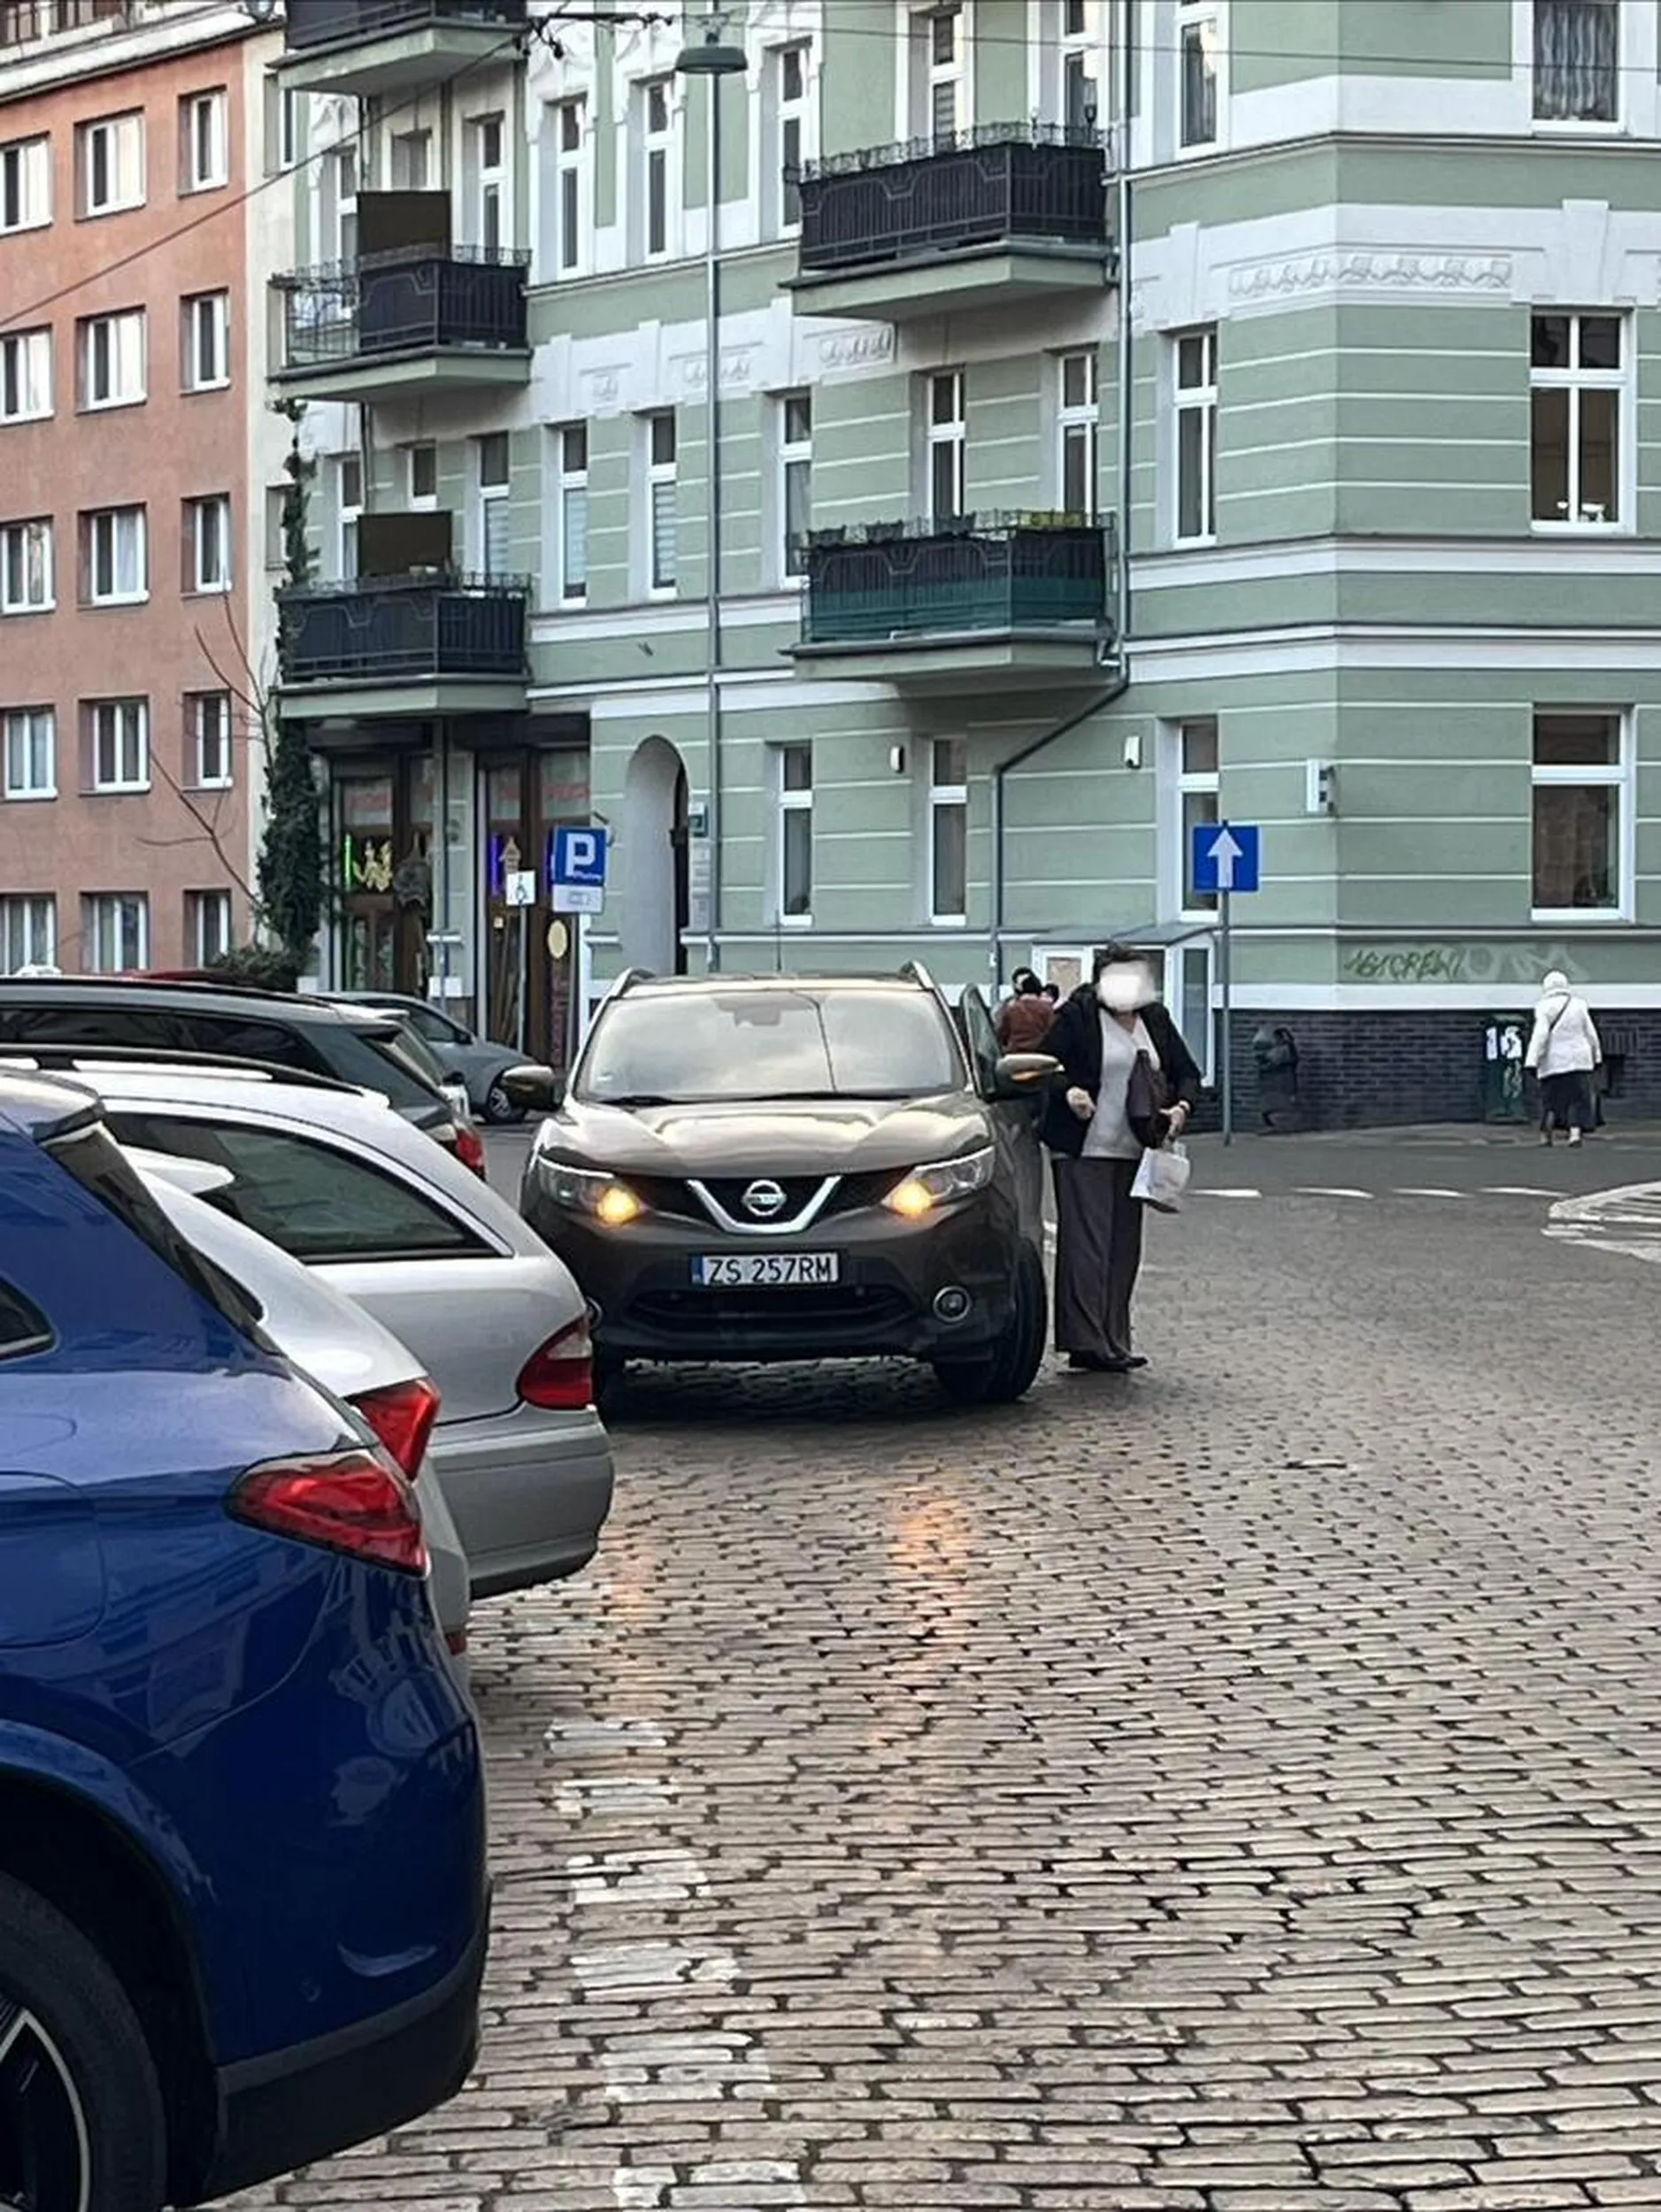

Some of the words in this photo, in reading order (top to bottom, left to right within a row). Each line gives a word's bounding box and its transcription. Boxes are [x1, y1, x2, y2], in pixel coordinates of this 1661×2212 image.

[565, 833, 596, 876] P
[709, 1259, 742, 1283] ZS
[752, 1257, 831, 1282] 257RM
